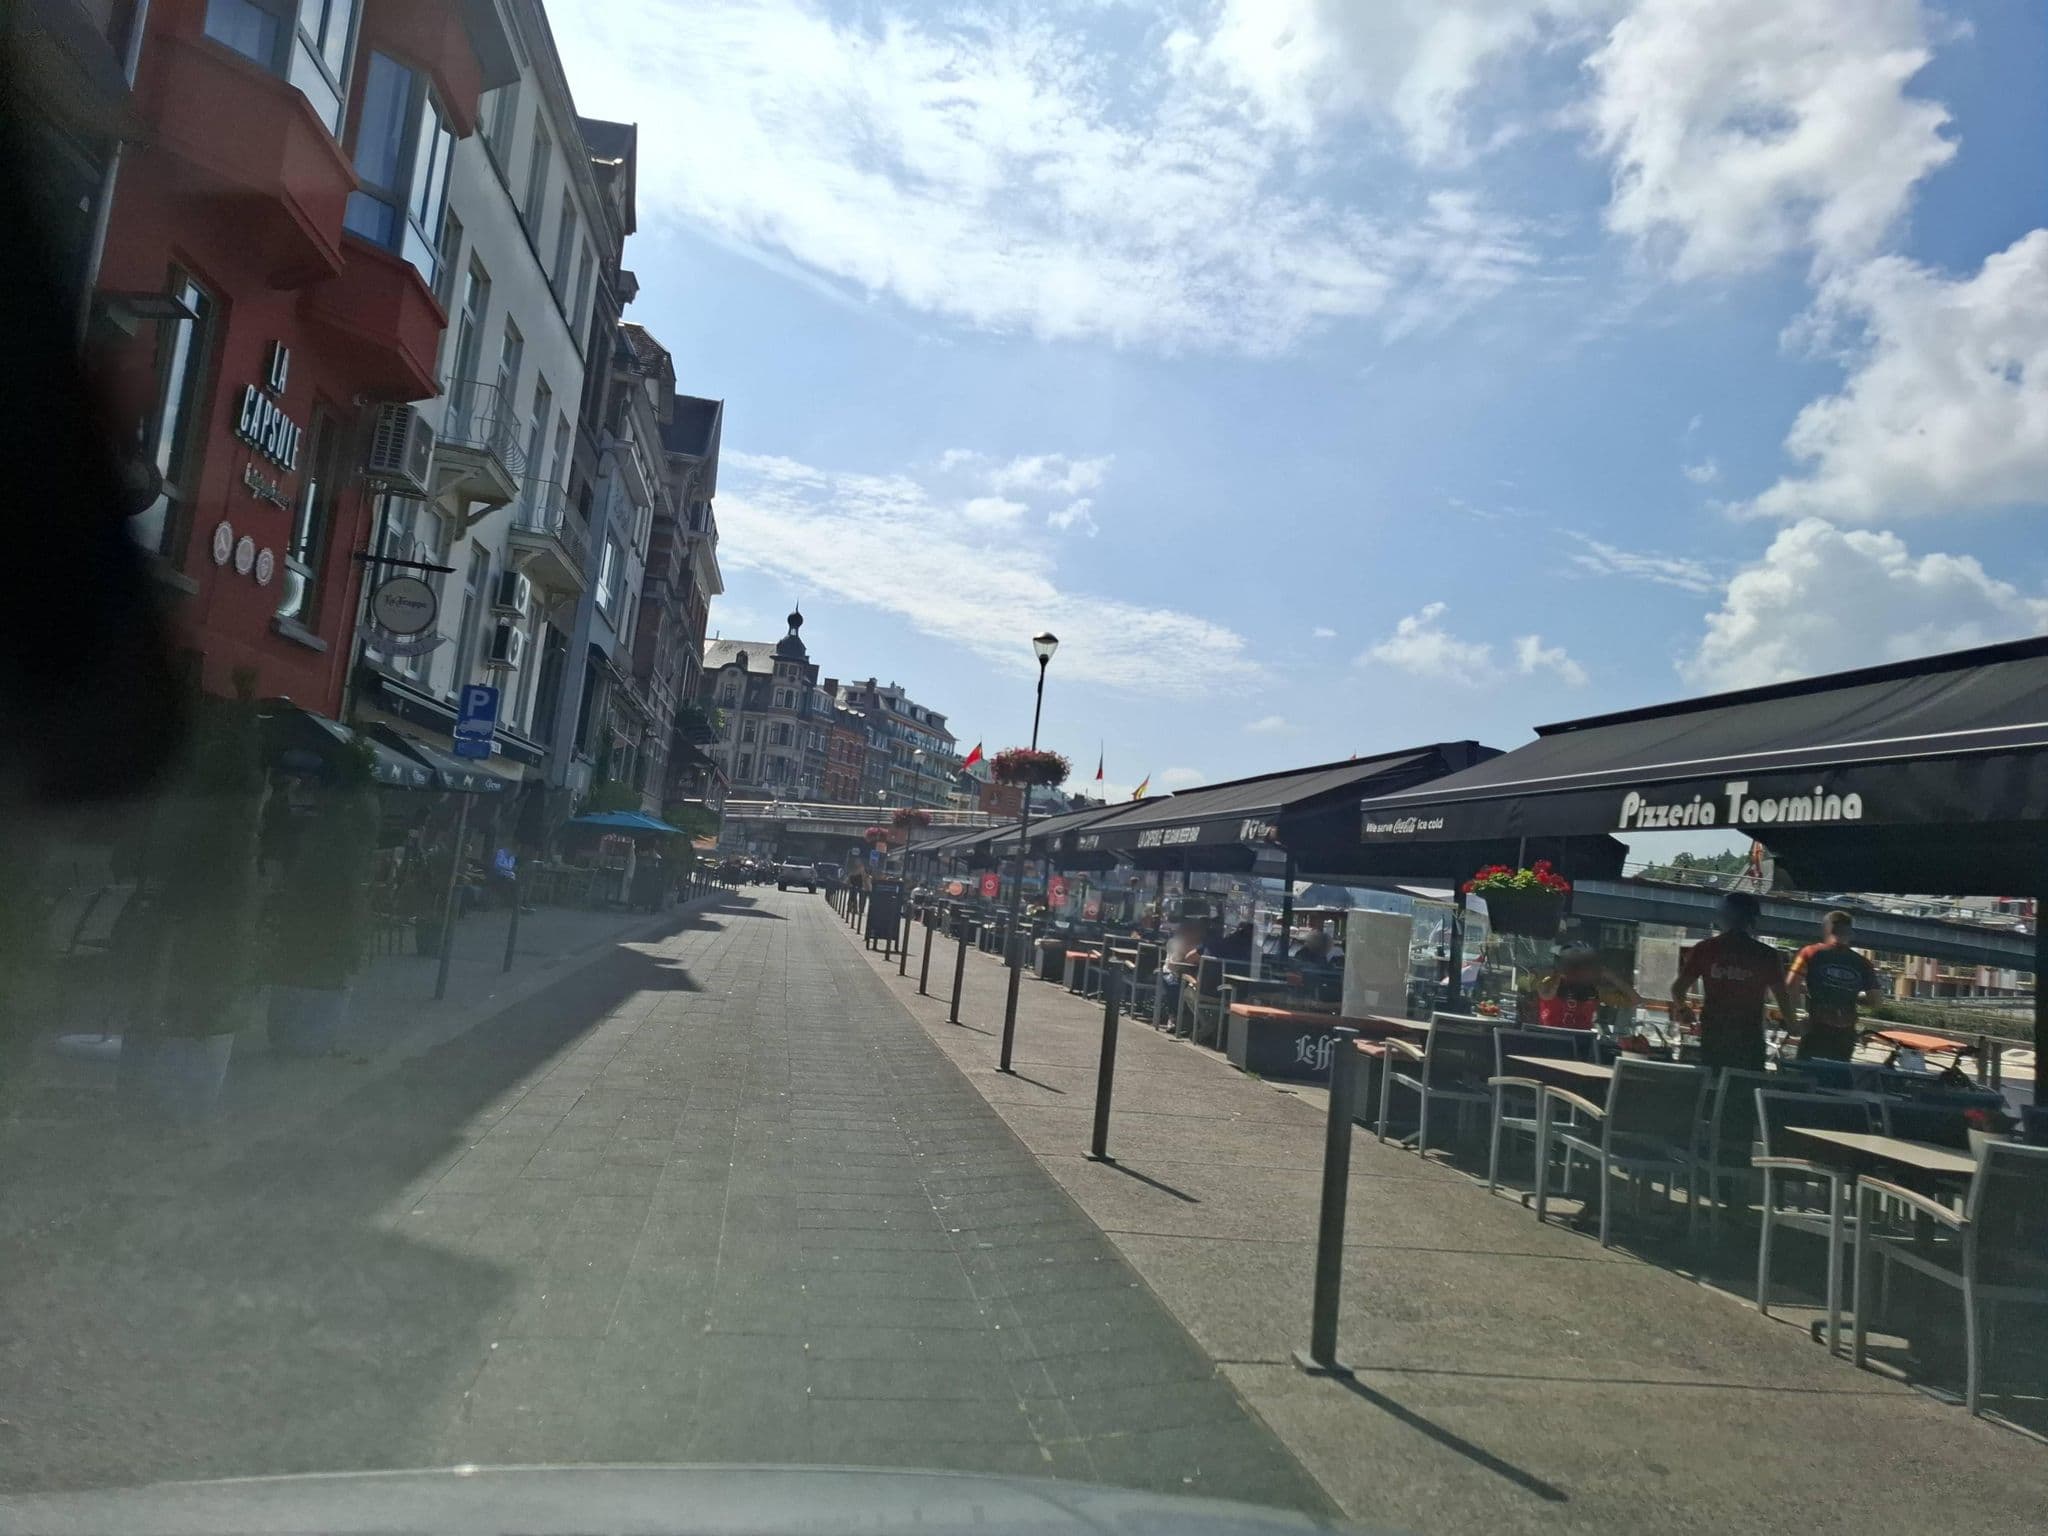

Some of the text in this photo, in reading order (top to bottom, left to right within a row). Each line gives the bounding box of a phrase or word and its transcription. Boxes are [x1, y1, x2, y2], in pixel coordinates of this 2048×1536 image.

[270, 340, 290, 394] LA
[240, 383, 302, 472] CAPSULE
[467, 690, 490, 717] P
[1417, 819, 1427, 830] ice
[1428, 817, 1444, 829] cold
[1618, 781, 1863, 829] Pizzeria Taormina
[1295, 1034, 1335, 1071] Leff
